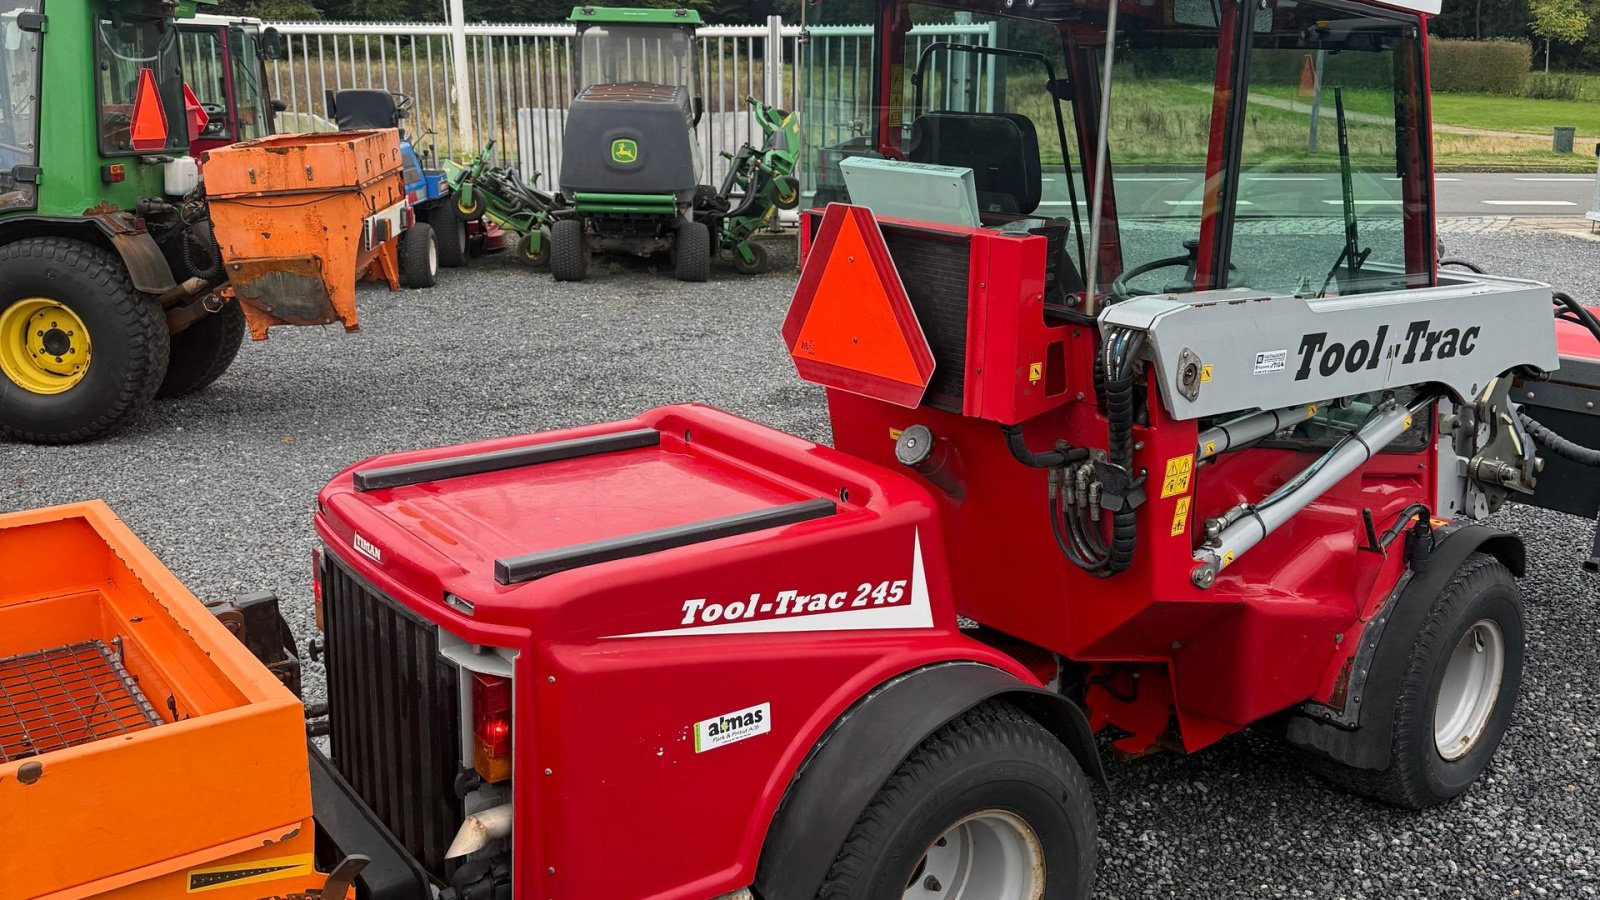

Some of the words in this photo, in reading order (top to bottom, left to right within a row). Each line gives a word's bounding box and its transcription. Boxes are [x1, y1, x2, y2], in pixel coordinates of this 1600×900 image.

[681, 590, 847, 624] Tool-Trac
[851, 580, 907, 607] 245
[708, 710, 763, 736] almas
